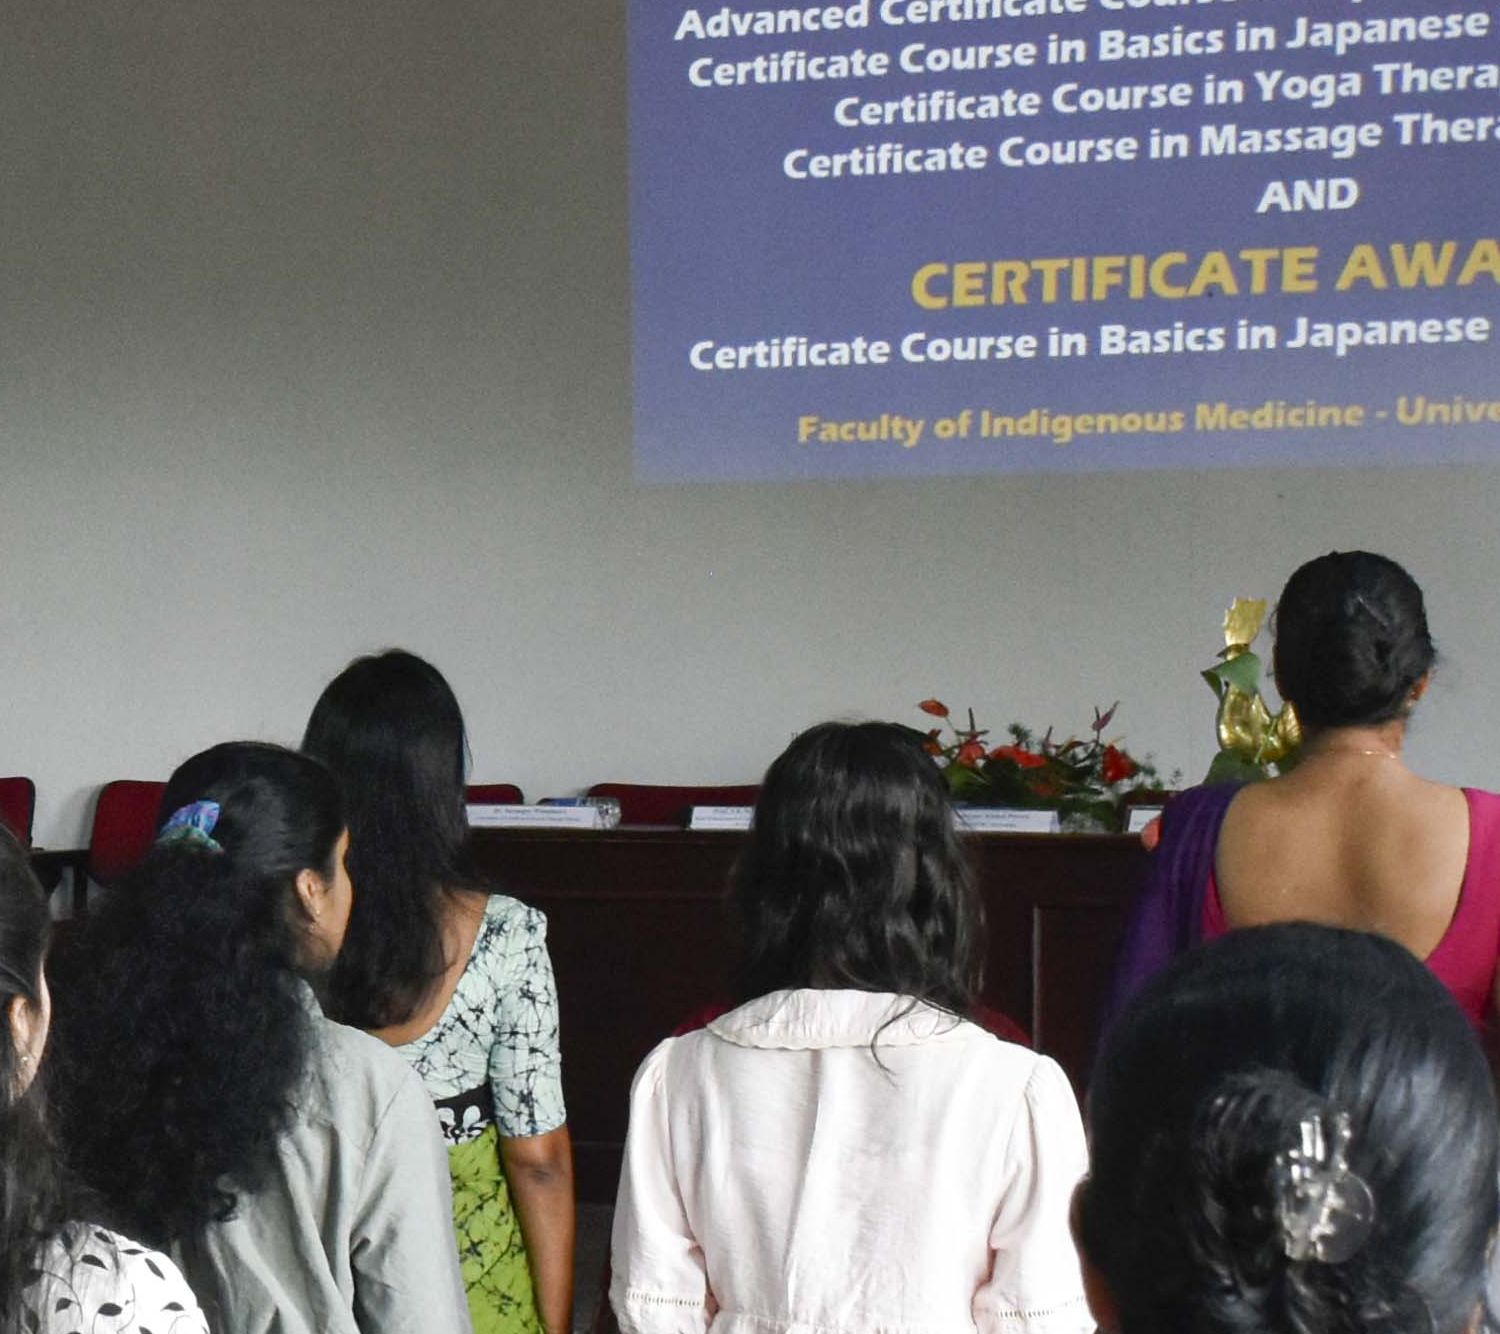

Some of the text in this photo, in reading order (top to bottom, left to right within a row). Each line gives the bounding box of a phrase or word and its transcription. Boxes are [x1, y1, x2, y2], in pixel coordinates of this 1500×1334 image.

[689, 49, 890, 87] Certificate
[900, 43, 1037, 73] Course
[1048, 33, 1086, 64] in
[1099, 25, 1224, 60] Basics
[1236, 21, 1276, 51] in
[1286, 12, 1490, 55] Japanese
[834, 89, 1042, 126] Certificate
[1052, 83, 1193, 113] Course
[1204, 74, 1244, 104] in
[1254, 70, 1362, 108] Yoga
[783, 142, 988, 179] Certificate
[999, 136, 1139, 167] Course
[1150, 128, 1189, 159] in
[1200, 123, 1383, 158] Massage
[1256, 178, 1360, 213] AND
[912, 247, 1319, 309] CERTIFICATE
[690, 336, 891, 370] Certificate
[901, 332, 1038, 362] Course
[1049, 327, 1087, 357] in
[1101, 322, 1225, 355] Basics
[1237, 319, 1277, 350] in
[1287, 317, 1490, 356] Japanese
[797, 412, 925, 448] Faculty
[933, 408, 972, 439] of
[980, 408, 1185, 443] Indigenous
[1195, 401, 1364, 430] Medicine
